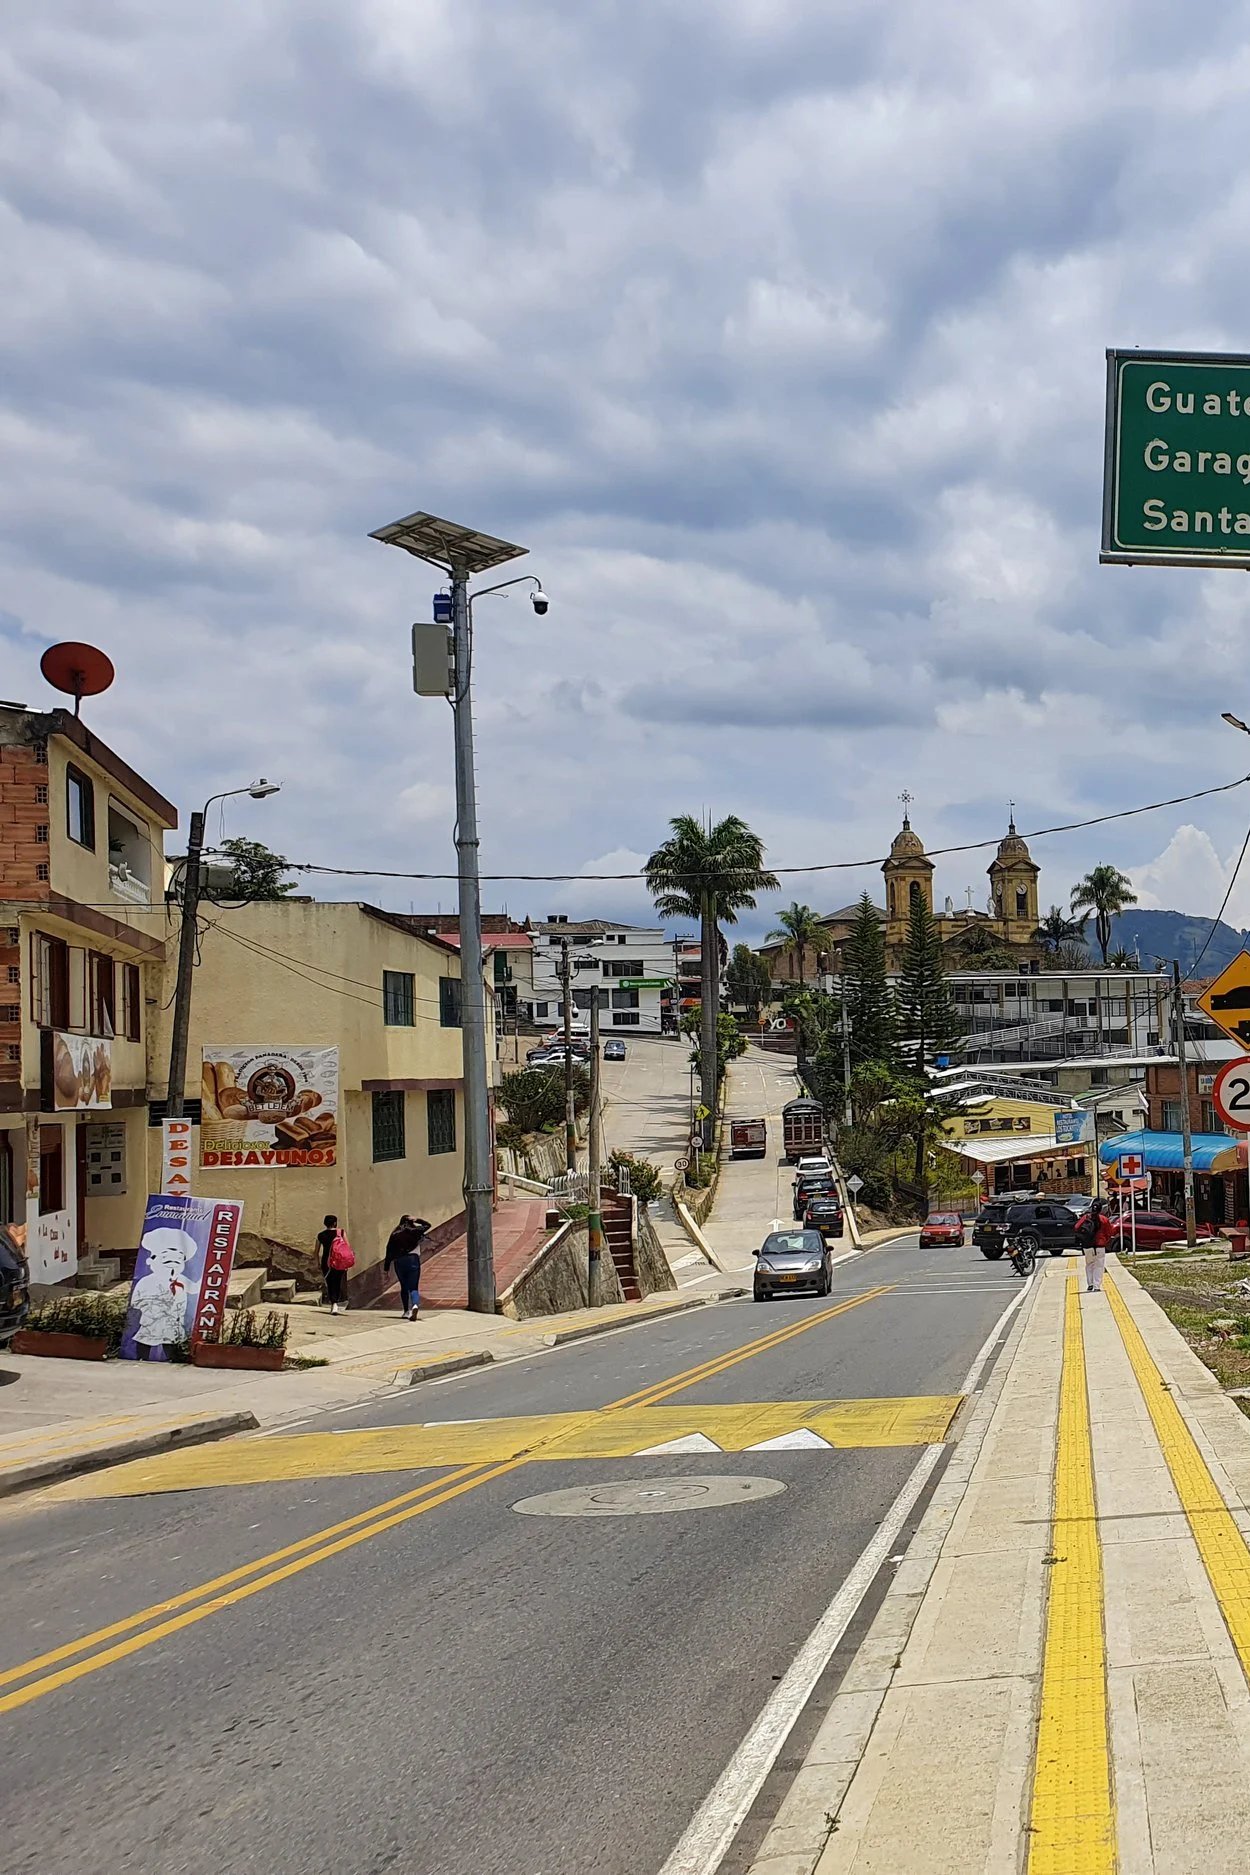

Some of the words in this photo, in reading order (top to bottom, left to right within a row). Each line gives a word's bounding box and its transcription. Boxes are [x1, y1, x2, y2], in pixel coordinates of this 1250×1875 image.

[204, 1139, 271, 1151] Deliciosos
[204, 1149, 335, 1166] DESAYUNOS
[677, 1160, 687, 1168] 30
